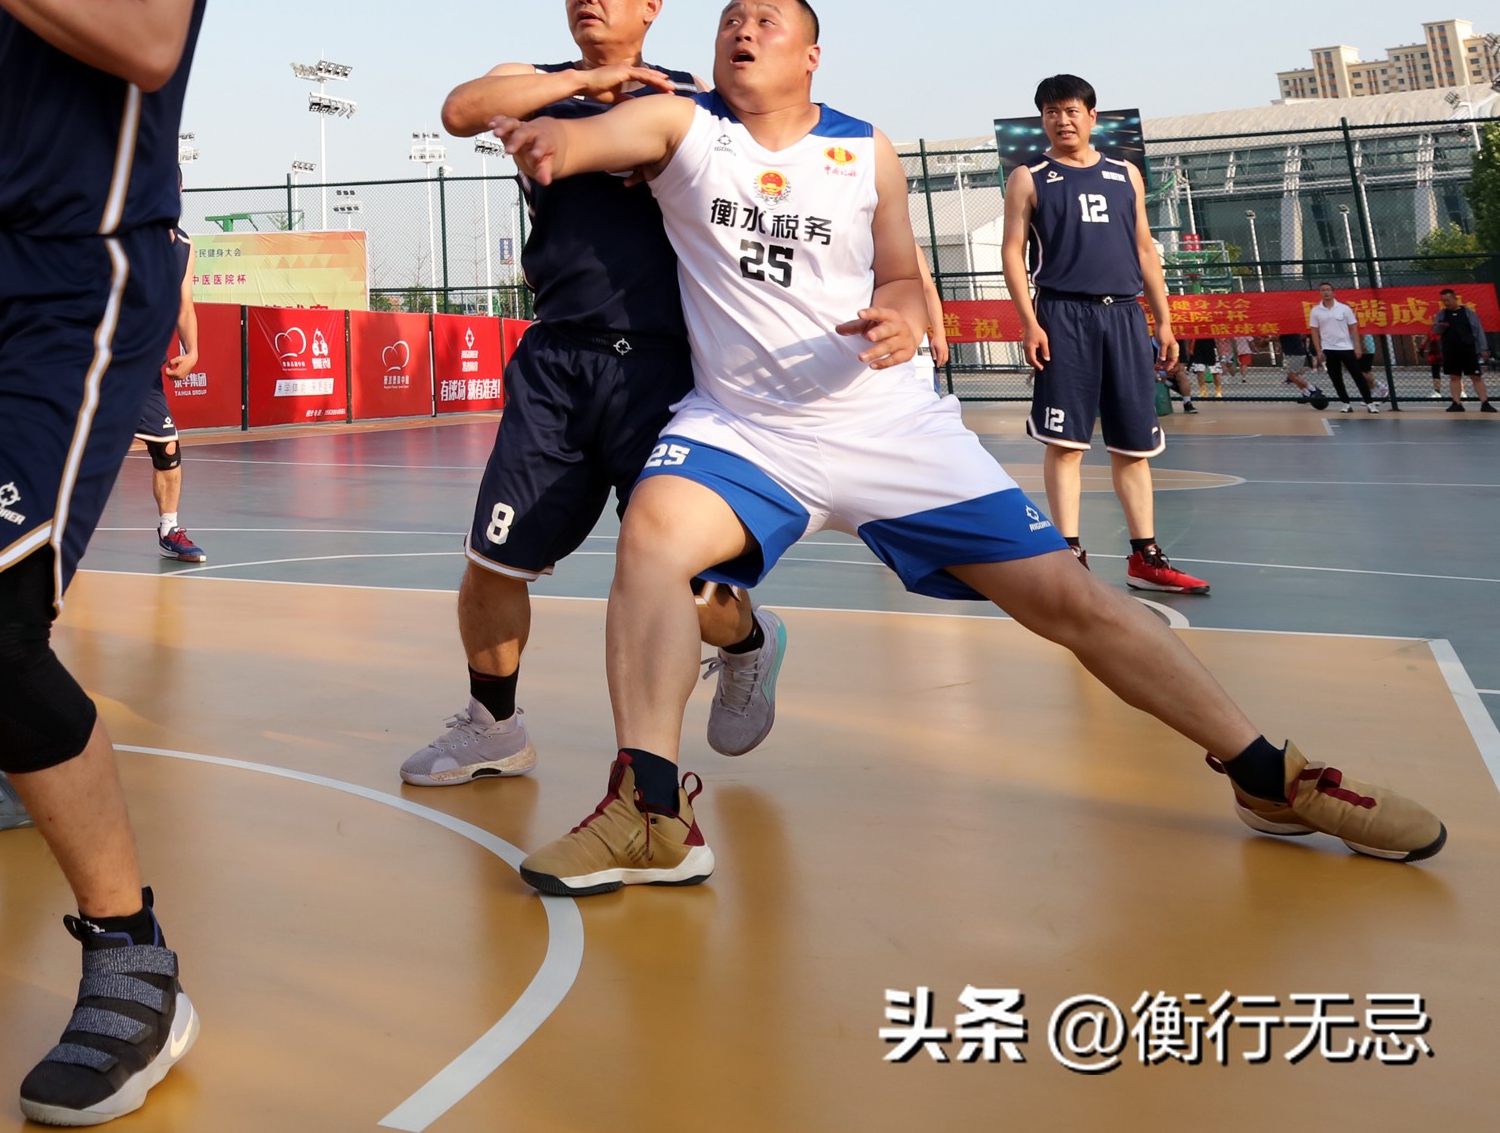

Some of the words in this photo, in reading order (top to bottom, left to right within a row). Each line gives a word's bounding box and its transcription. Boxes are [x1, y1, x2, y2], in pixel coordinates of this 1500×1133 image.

[710, 197, 833, 246] 衡水税务
[1078, 193, 1110, 223] 12
[739, 238, 795, 289] 25
[1301, 296, 1477, 330] 满成
[1044, 406, 1066, 434] 12
[644, 443, 691, 468] 25
[485, 501, 516, 546] 8
